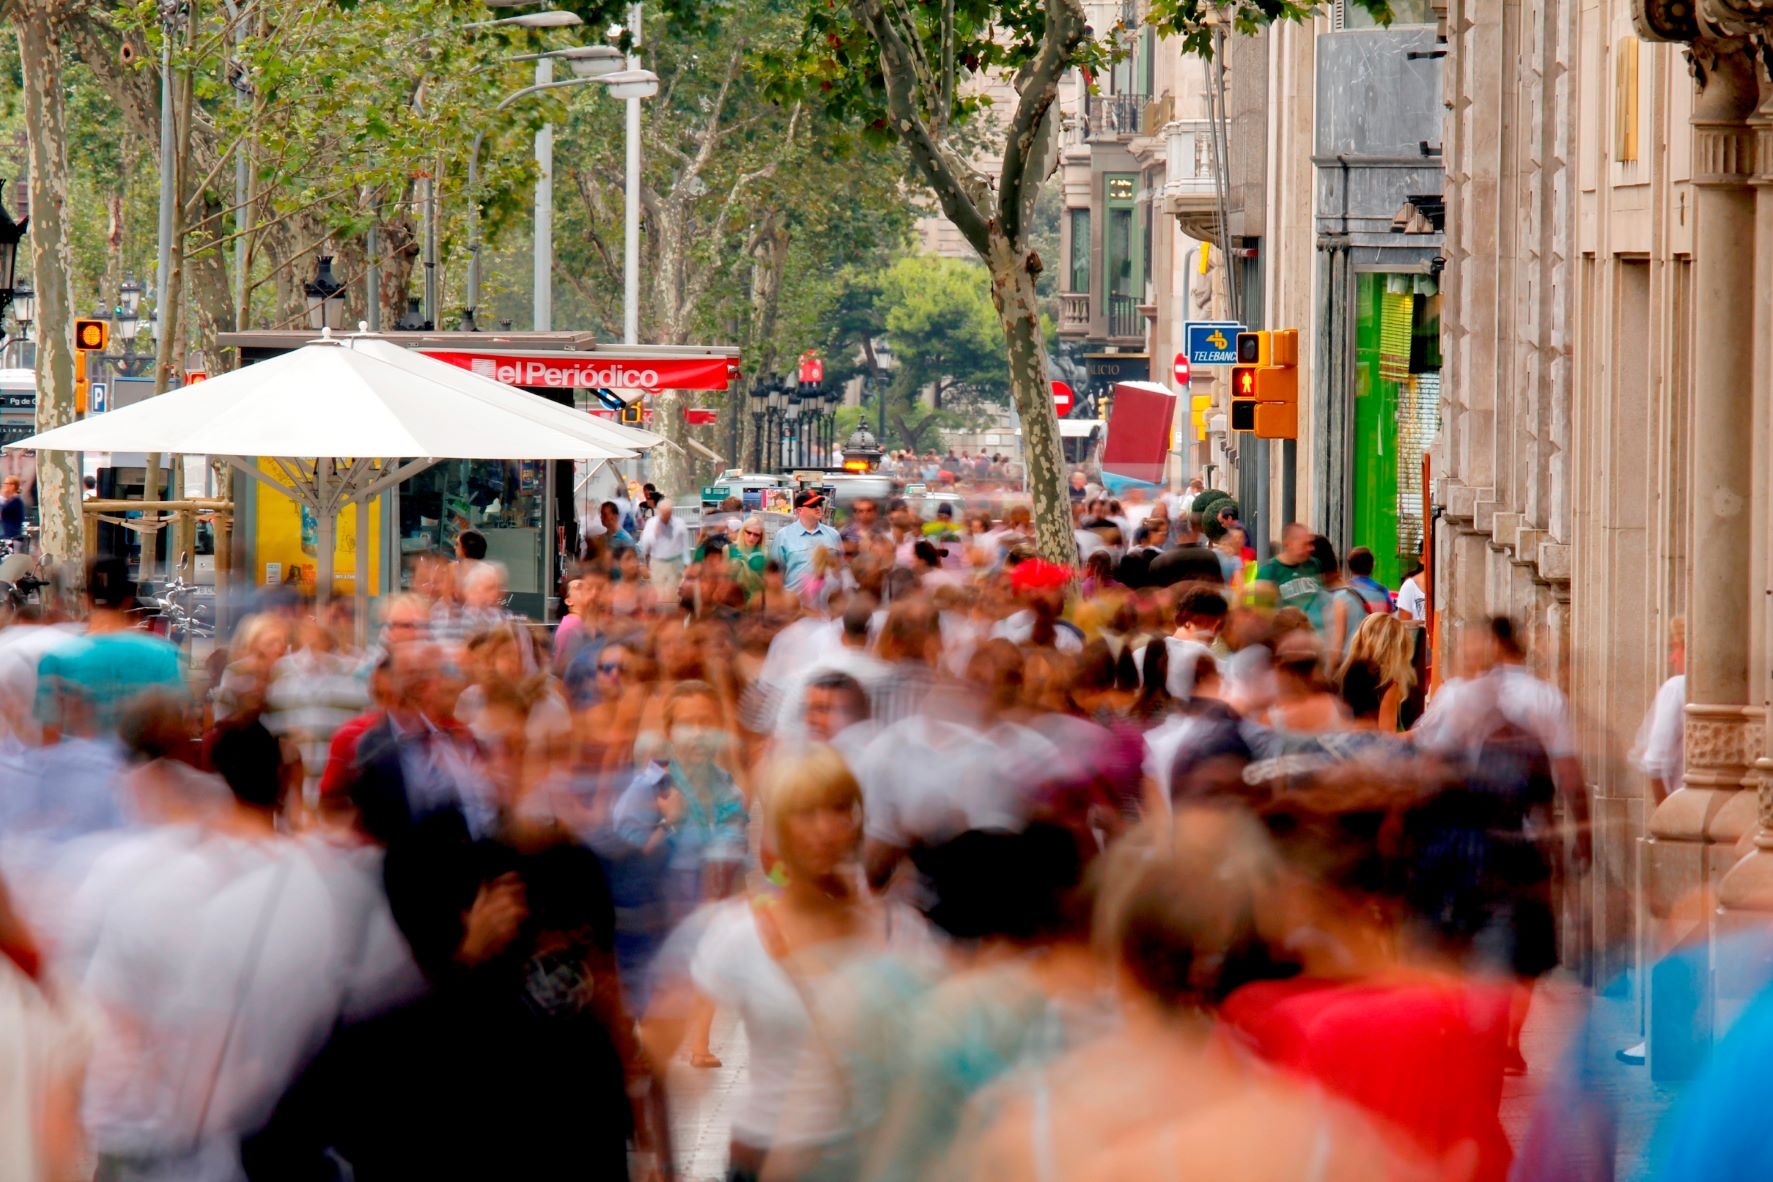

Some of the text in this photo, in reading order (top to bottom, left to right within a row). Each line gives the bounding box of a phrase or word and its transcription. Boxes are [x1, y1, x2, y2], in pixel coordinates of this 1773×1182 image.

[1193, 351, 1237, 362] TELEBANC
[497, 361, 658, 388] el Periódico
[9, 398, 20, 406] Pg
[94, 387, 104, 409] P
